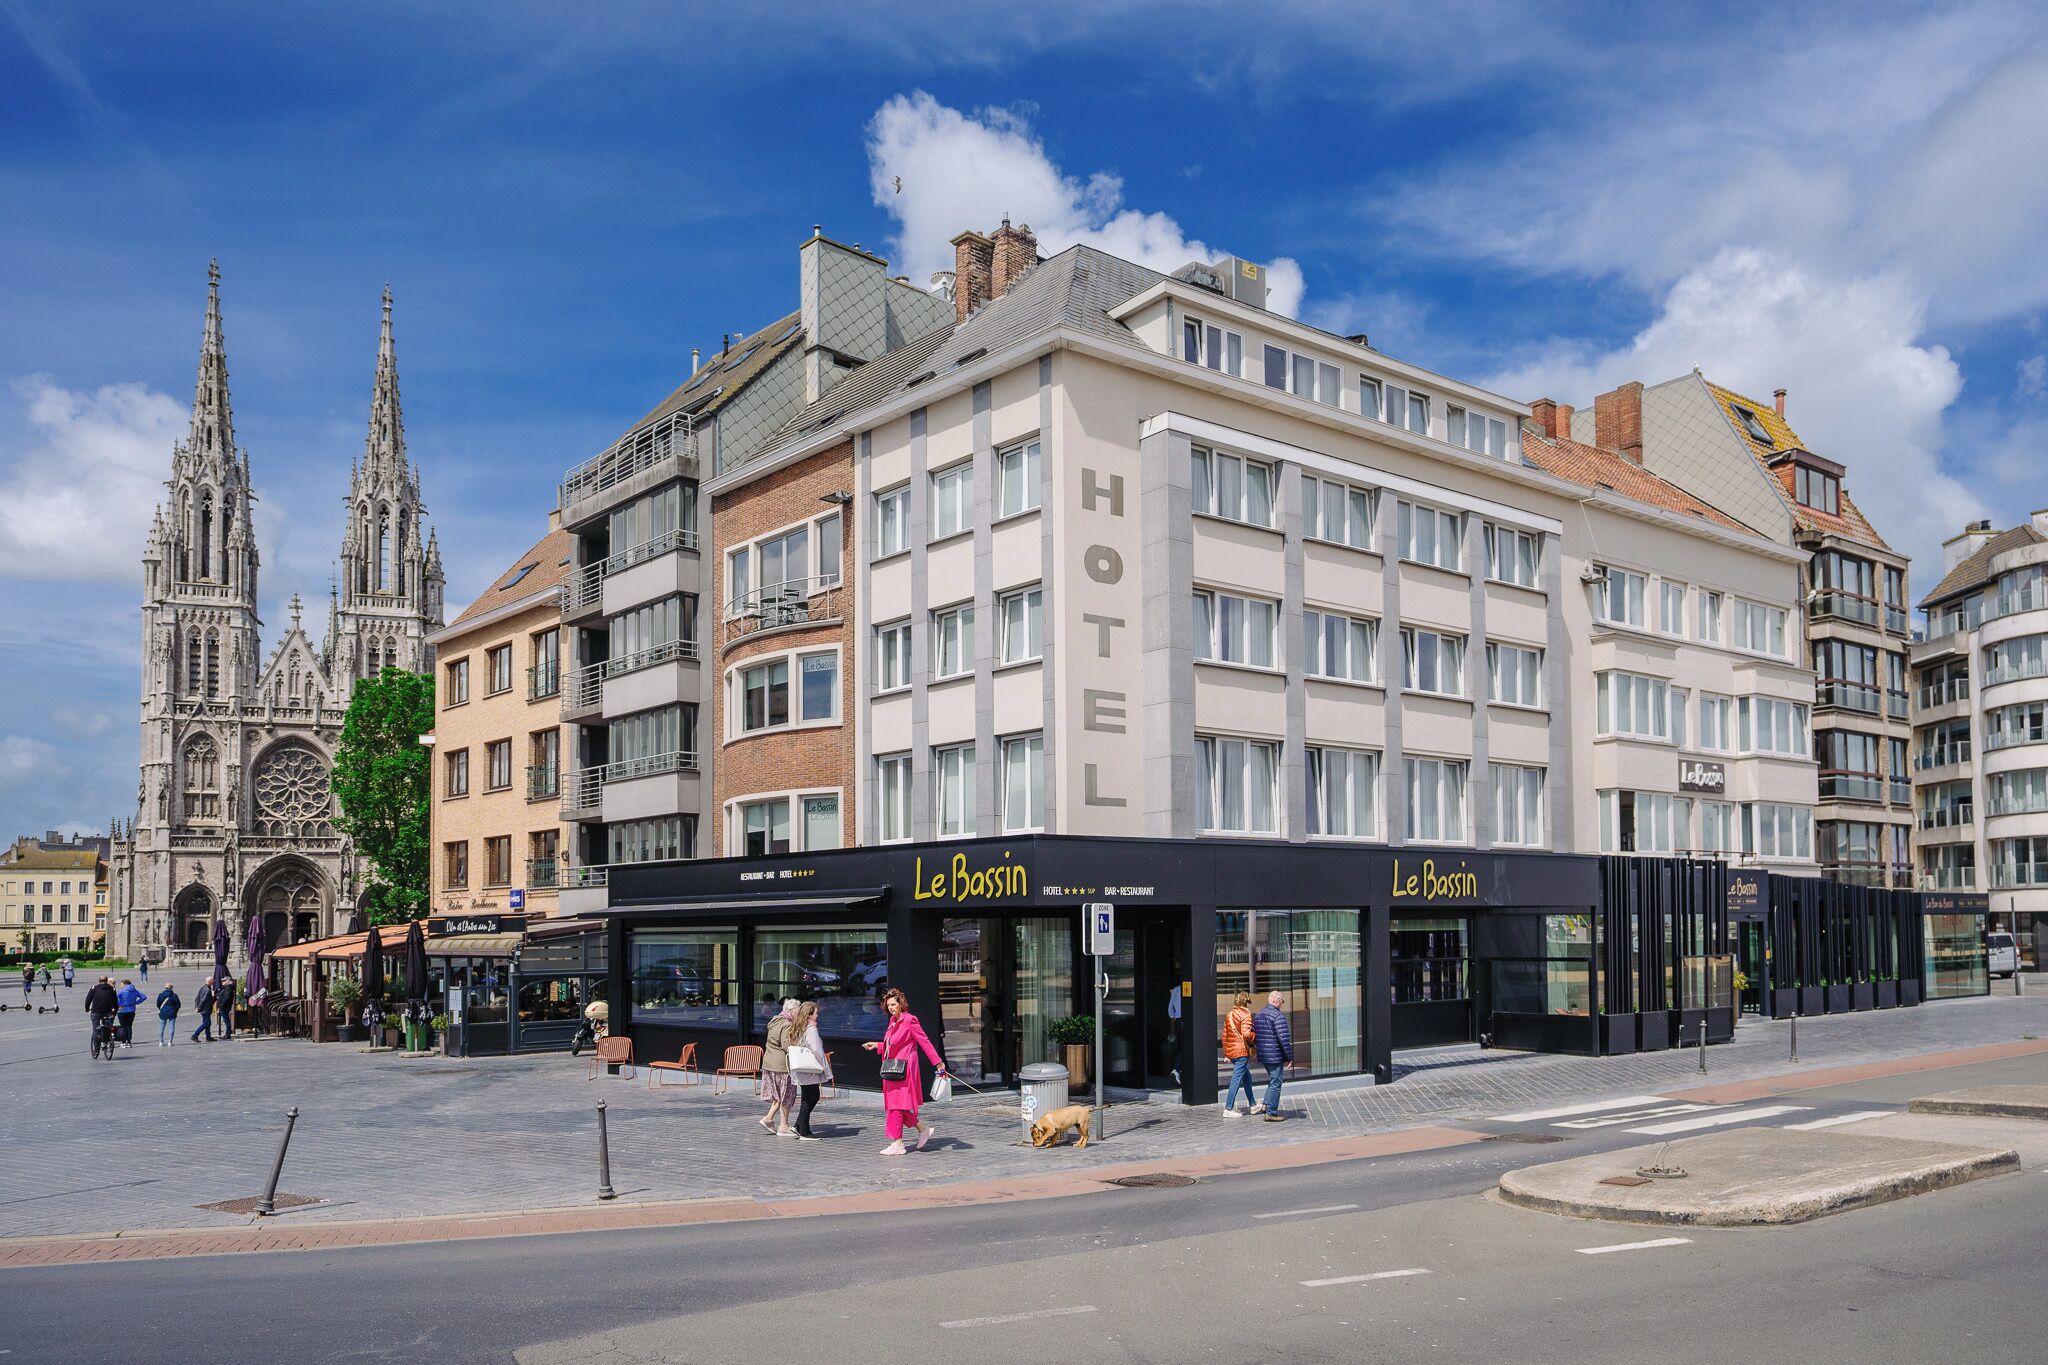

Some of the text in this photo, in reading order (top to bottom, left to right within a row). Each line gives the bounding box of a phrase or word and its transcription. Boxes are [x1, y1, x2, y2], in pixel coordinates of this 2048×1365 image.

[1082, 467, 1127, 807] HOTEL
[807, 658, 836, 671] Le Bassin
[1681, 762, 1696, 783] Le
[807, 801, 837, 812] Le Bassin
[780, 870, 792, 879] HOTEL
[915, 851, 1027, 902] Le Bassin
[1393, 858, 1477, 900] Le Bassin
[1043, 886, 1062, 896] HOTEL
[1120, 886, 1155, 896] RESTAURANT
[1736, 877, 1758, 897] Bassin
